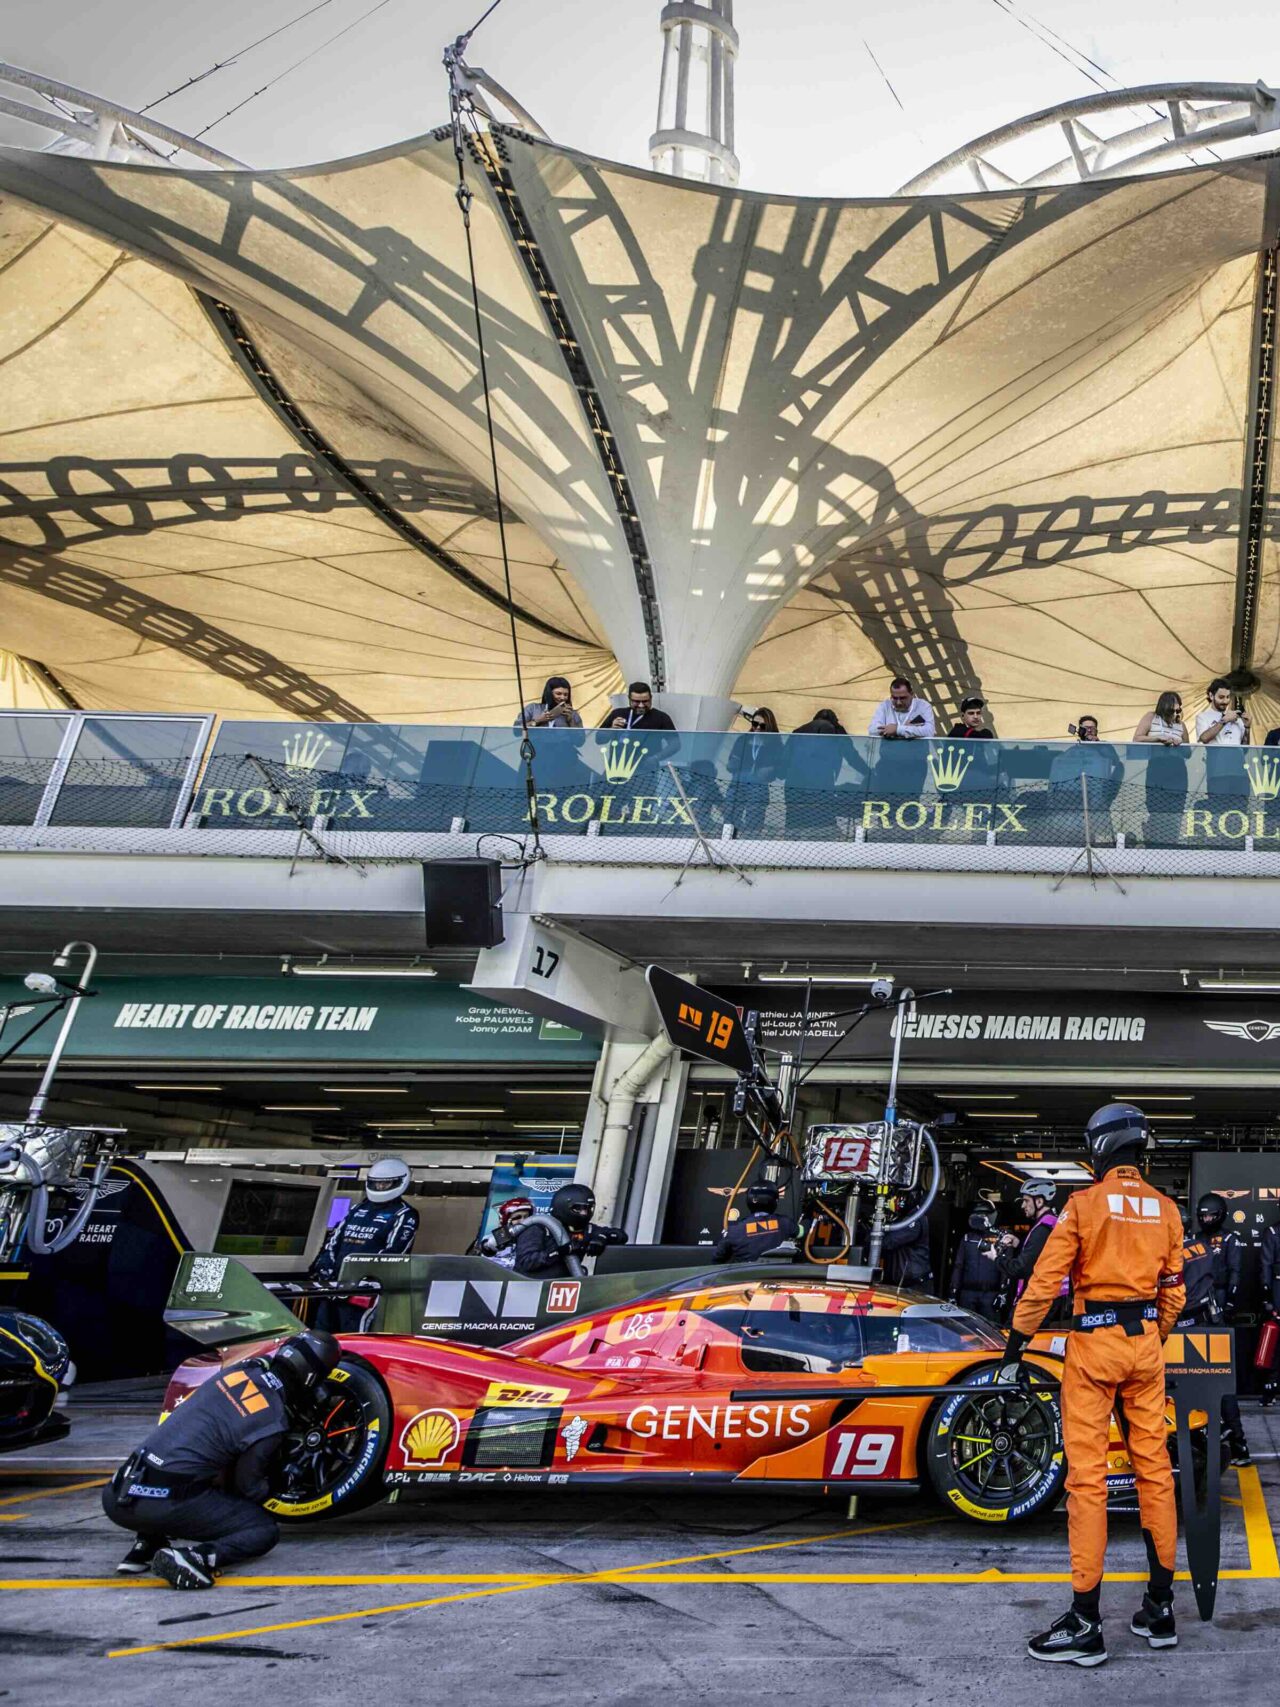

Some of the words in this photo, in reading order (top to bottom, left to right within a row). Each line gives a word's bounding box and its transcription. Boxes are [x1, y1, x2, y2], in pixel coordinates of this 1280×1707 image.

[201, 788, 377, 818] ROLEX
[522, 794, 699, 825] ROLEX
[861, 801, 1027, 833] ROLEX
[532, 946, 559, 978] 17
[113, 1003, 196, 1028] HEART
[192, 1004, 228, 1029] OF
[223, 1005, 315, 1030] RACING
[314, 1007, 378, 1031] TEAM
[468, 1007, 491, 1015] Gray
[483, 1016, 534, 1024] PAUWELS
[760, 1011, 788, 1019] athieu
[470, 1025, 498, 1034] Jonny
[501, 1025, 532, 1033] ADAM
[706, 1010, 734, 1050] 19
[983, 1015, 1062, 1040] MAGMA
[1063, 1016, 1147, 1042] RACING
[826, 1142, 867, 1167] 19
[79, 1234, 113, 1243] RACING
[87, 1224, 117, 1233] HEART
[549, 1287, 578, 1307] HY
[421, 1322, 462, 1331] GENESIS
[464, 1322, 498, 1331] MAGMA
[499, 1322, 536, 1331] RACING
[1189, 1367, 1210, 1375] MAGMA
[1210, 1367, 1232, 1375] RACING
[498, 1388, 554, 1403] DHL
[626, 1405, 811, 1440] GENESIS
[831, 1432, 895, 1476] 19
[337, 1440, 375, 1498] MICHELIN
[458, 1472, 496, 1483] DAC
[514, 1473, 543, 1483] Helinox
[1013, 1470, 1055, 1516] MICHELIN
